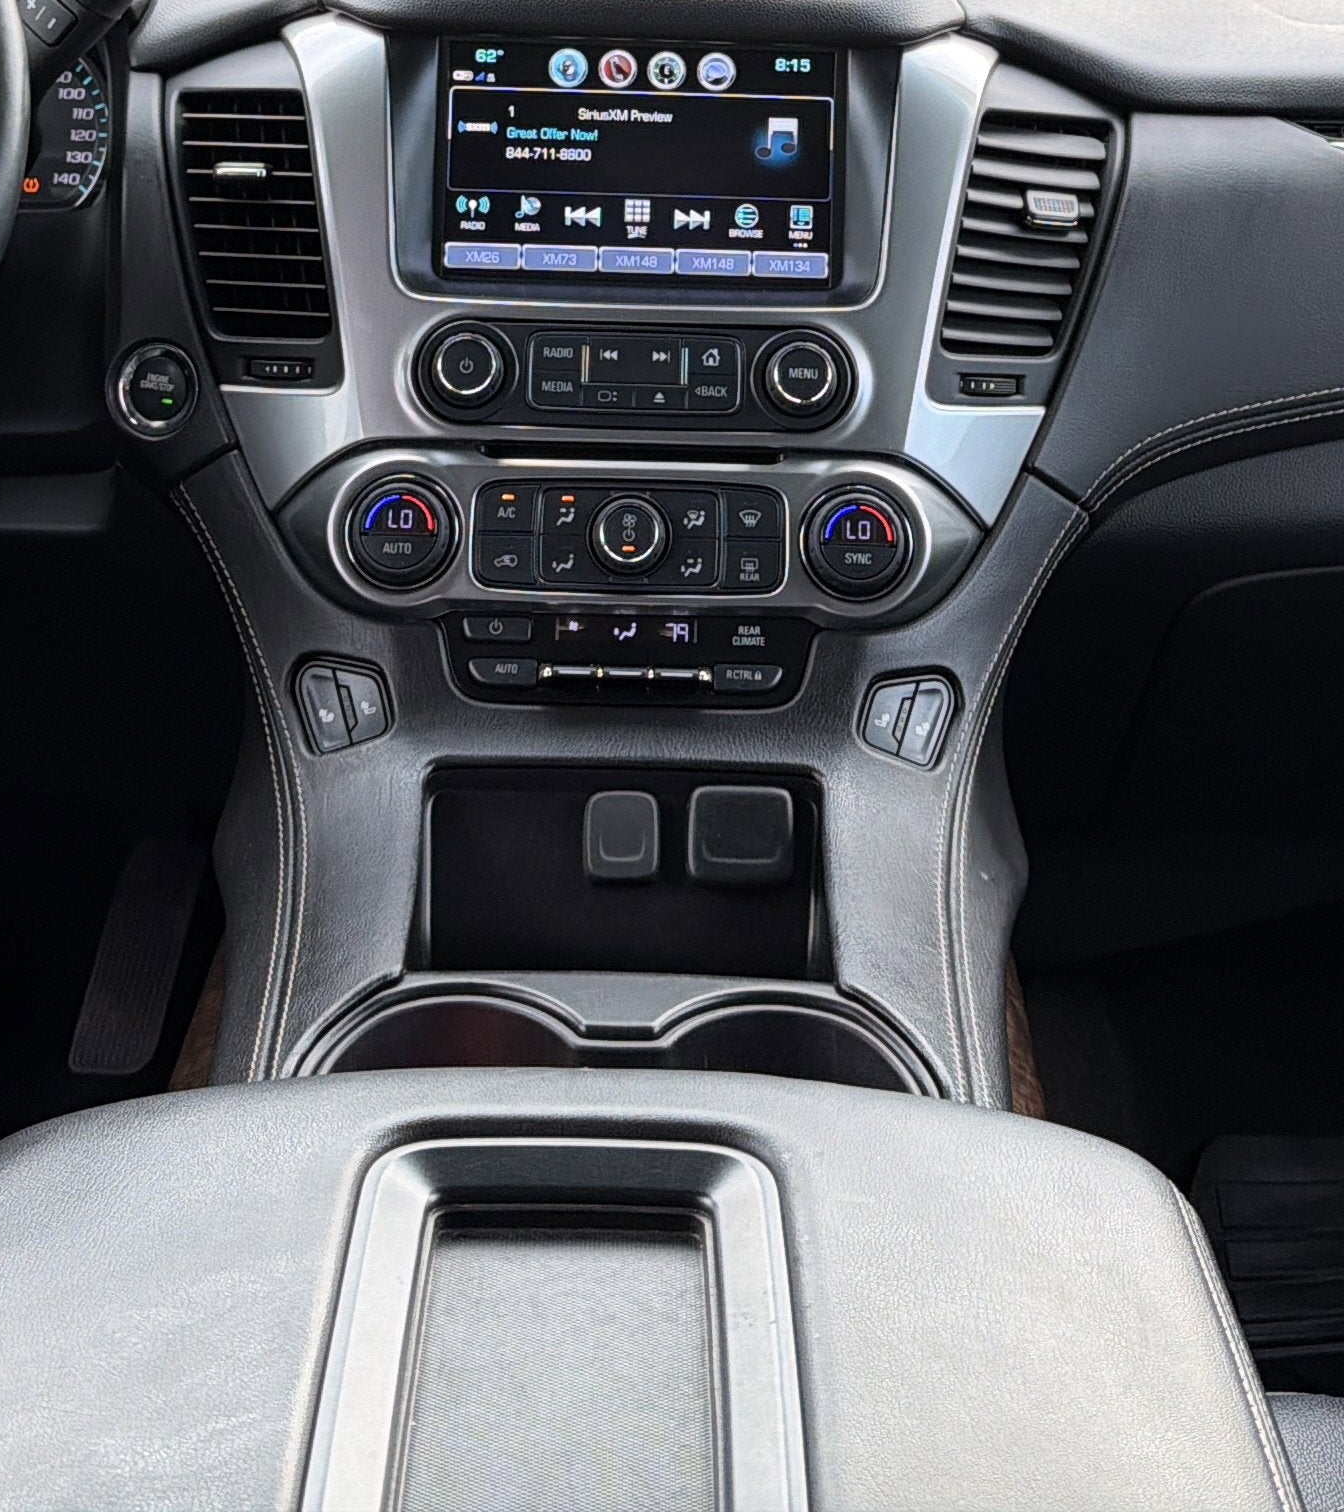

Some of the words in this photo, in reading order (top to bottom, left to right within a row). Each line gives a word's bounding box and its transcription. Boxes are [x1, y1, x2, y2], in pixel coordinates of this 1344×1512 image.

[774, 57, 811, 73] 8:15
[58, 88, 86, 100] 100
[72, 107, 95, 120] 110
[577, 107, 628, 122] SiriusXM
[630, 109, 673, 124] Preview
[70, 129, 97, 142] 120
[506, 126, 538, 140] Great
[540, 127, 568, 141] Offer
[571, 128, 599, 142] Now!
[66, 150, 93, 164] 130
[52, 173, 81, 186] 140
[459, 220, 486, 231] RADIO
[514, 222, 541, 232] MEDIA
[626, 224, 648, 235] TUNE
[728, 228, 764, 239] BROWSE
[788, 230, 813, 240] MENU
[465, 250, 500, 264] XM26
[542, 252, 577, 266] XM73
[615, 254, 658, 267] XM148
[692, 256, 735, 270] XM148
[768, 258, 810, 272] XM134
[543, 346, 574, 359] RADIO
[788, 367, 818, 379] MENU
[542, 381, 573, 393] MEDIA
[701, 386, 728, 398] BACK
[387, 509, 413, 529] LO
[497, 506, 516, 519] A/C
[846, 520, 871, 540] LO
[382, 542, 412, 555] AUTO
[844, 552, 872, 565] SYNC
[739, 573, 760, 582] REAR
[738, 625, 761, 636] REAR
[731, 635, 766, 647] CLIMATE
[494, 663, 518, 675] AUTO
